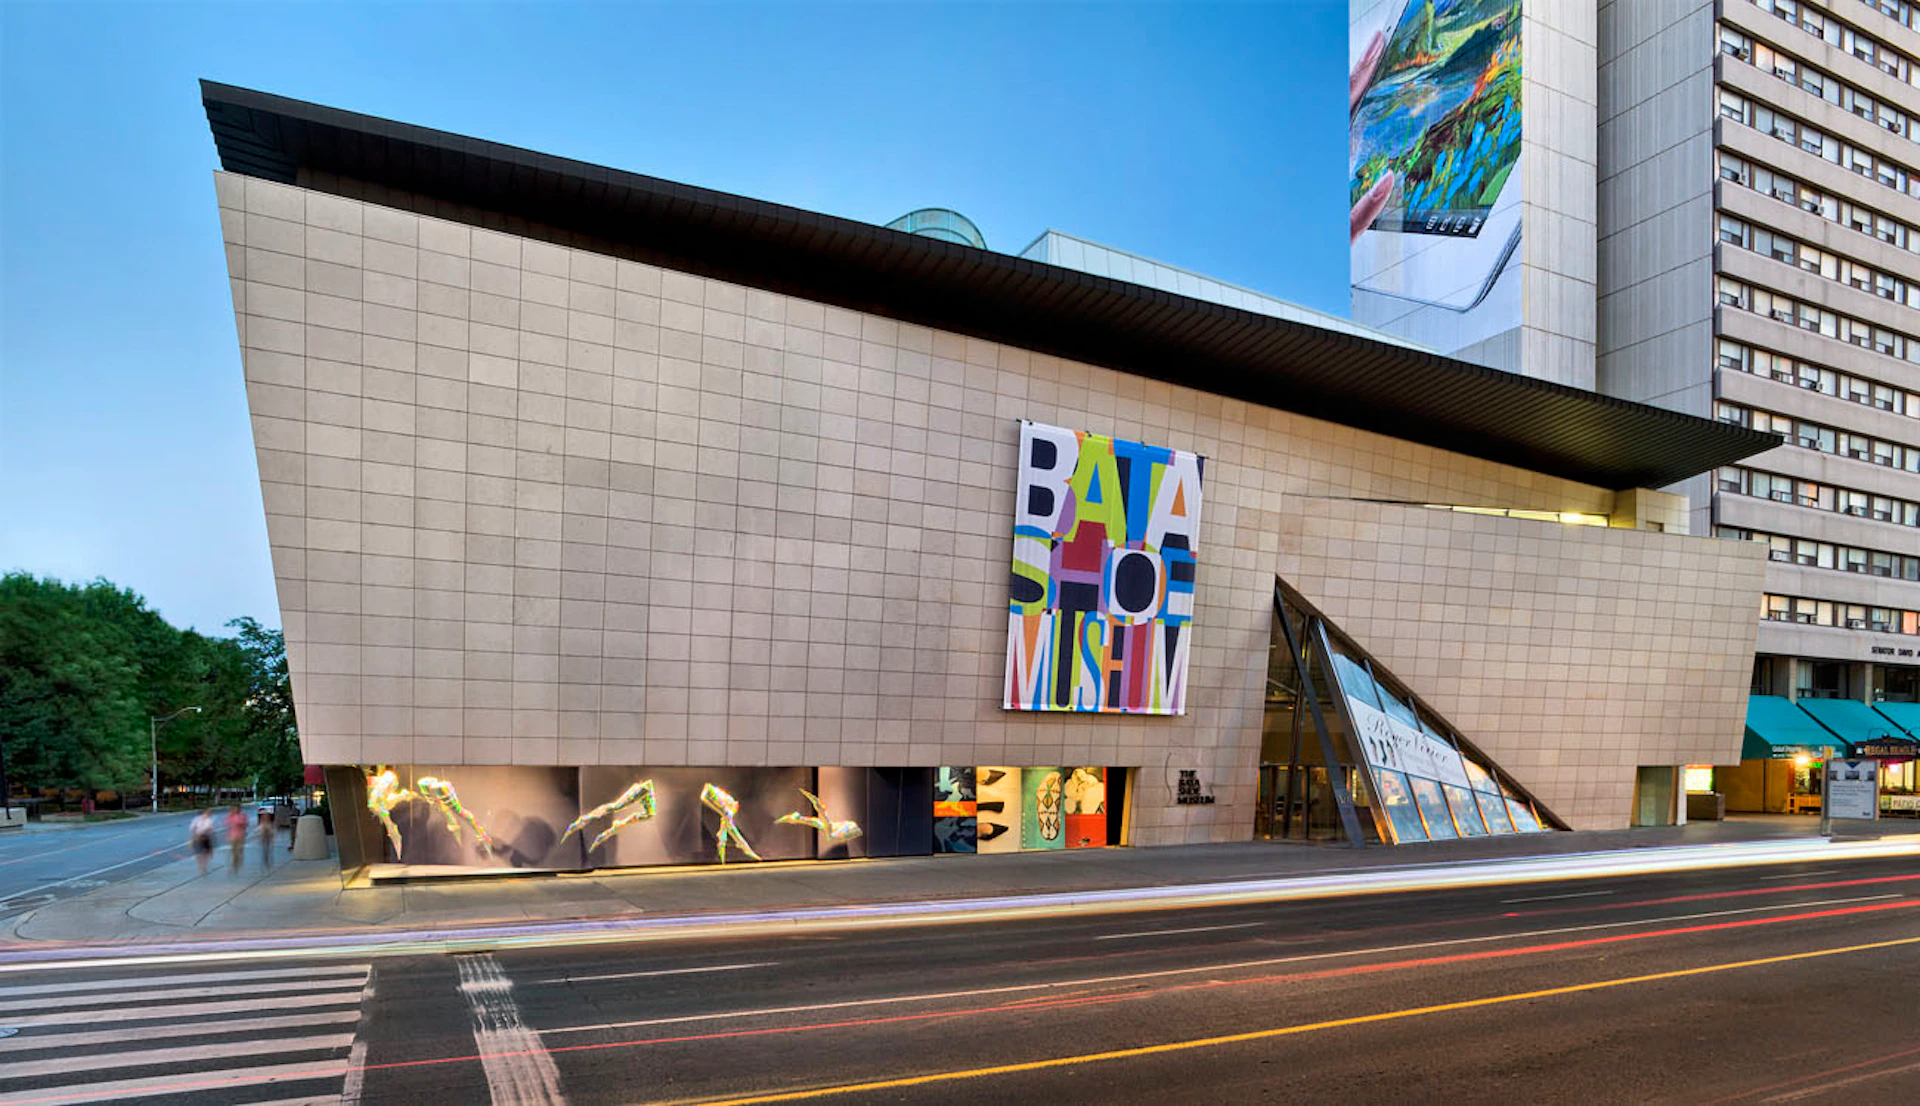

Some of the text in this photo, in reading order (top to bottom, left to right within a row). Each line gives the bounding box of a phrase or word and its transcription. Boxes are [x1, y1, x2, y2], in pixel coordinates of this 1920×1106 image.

[1015, 422, 1203, 554] BATA
[1010, 524, 1197, 627] SHOE
[1871, 646, 1895, 655] SENATOR
[1898, 648, 1914, 658] DAVID
[1004, 608, 1194, 714] MUSEUM
[1179, 770, 1197, 778] THE
[1178, 779, 1200, 787] BATA
[1178, 786, 1201, 794] SHOE
[1177, 795, 1216, 804] MUSEUM
